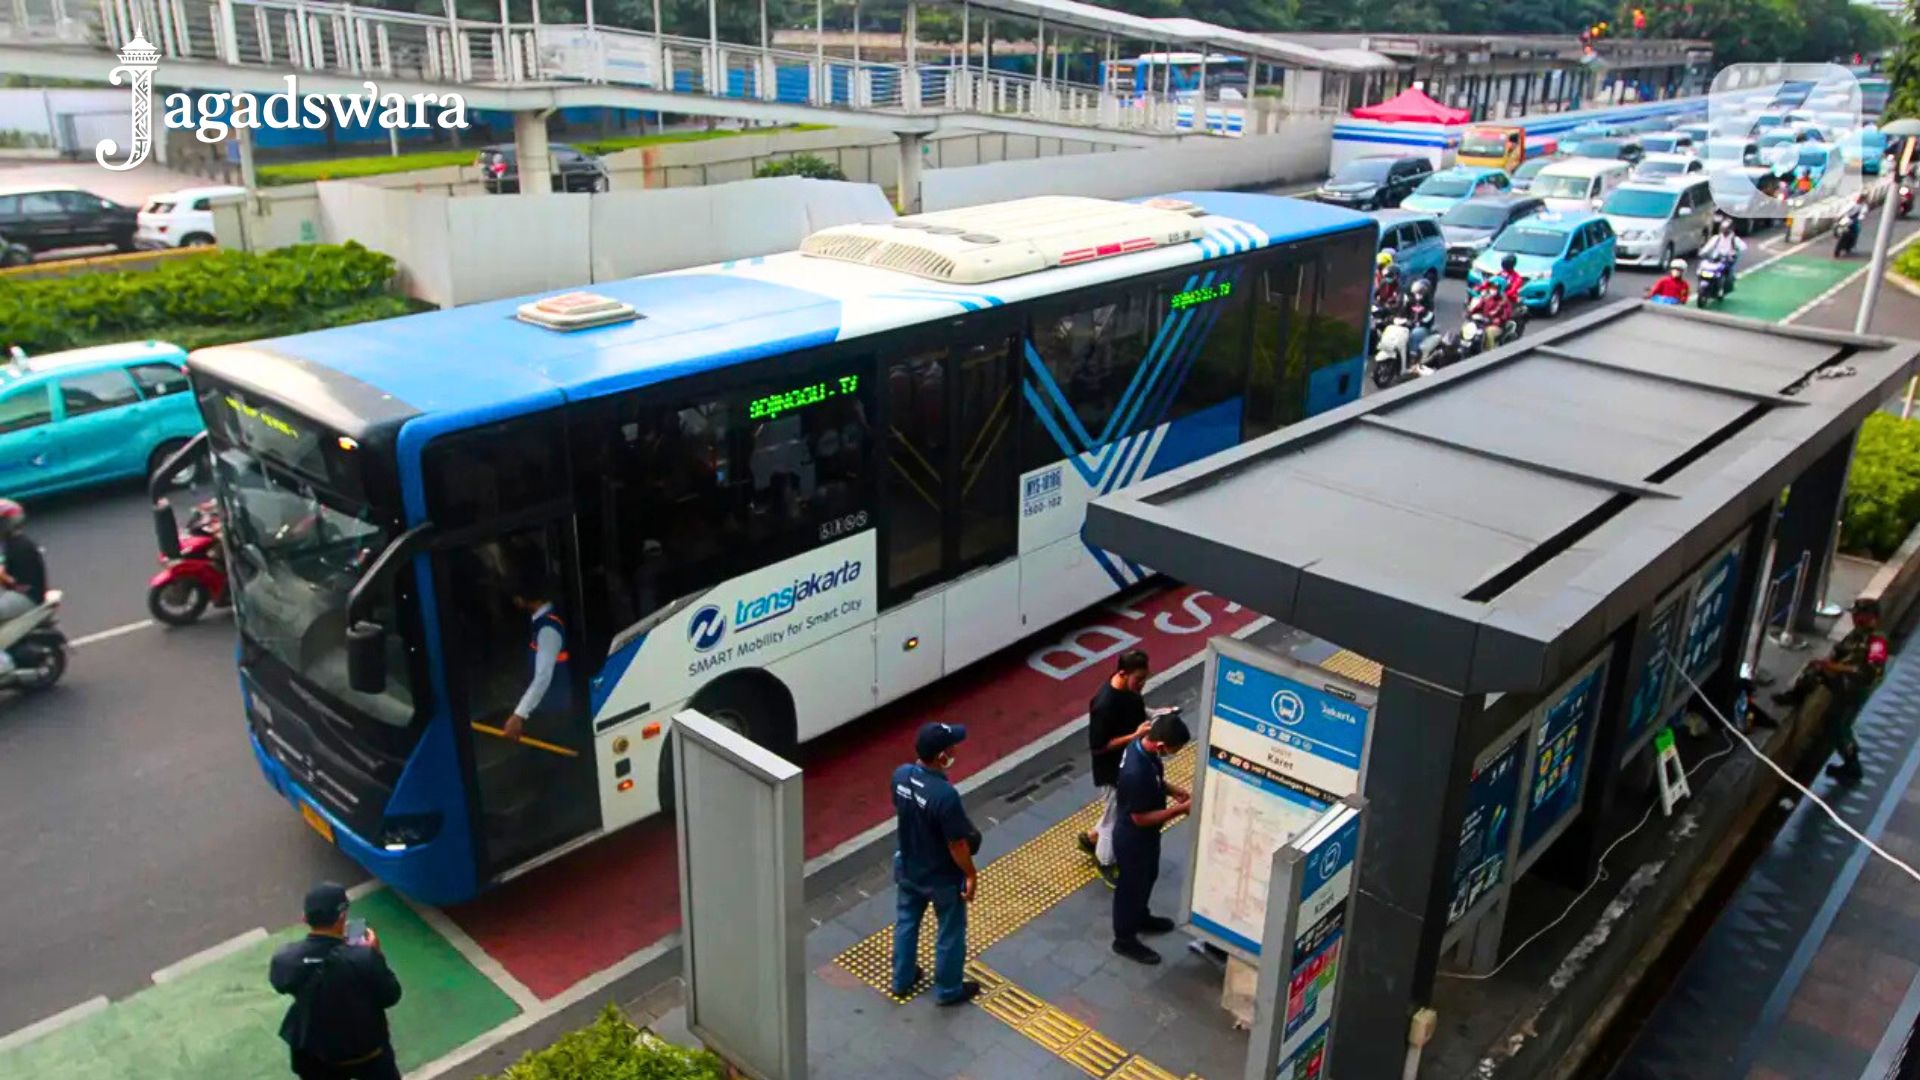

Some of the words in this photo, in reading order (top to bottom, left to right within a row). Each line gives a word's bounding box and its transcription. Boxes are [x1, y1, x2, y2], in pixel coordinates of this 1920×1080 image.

[734, 560, 862, 632] transjakarta
[688, 648, 734, 677] SMART
[737, 629, 785, 656] Mobility
[787, 620, 804, 637] for
[806, 606, 838, 629] Smart
[841, 598, 862, 615] City
[1267, 753, 1294, 770] Karet
